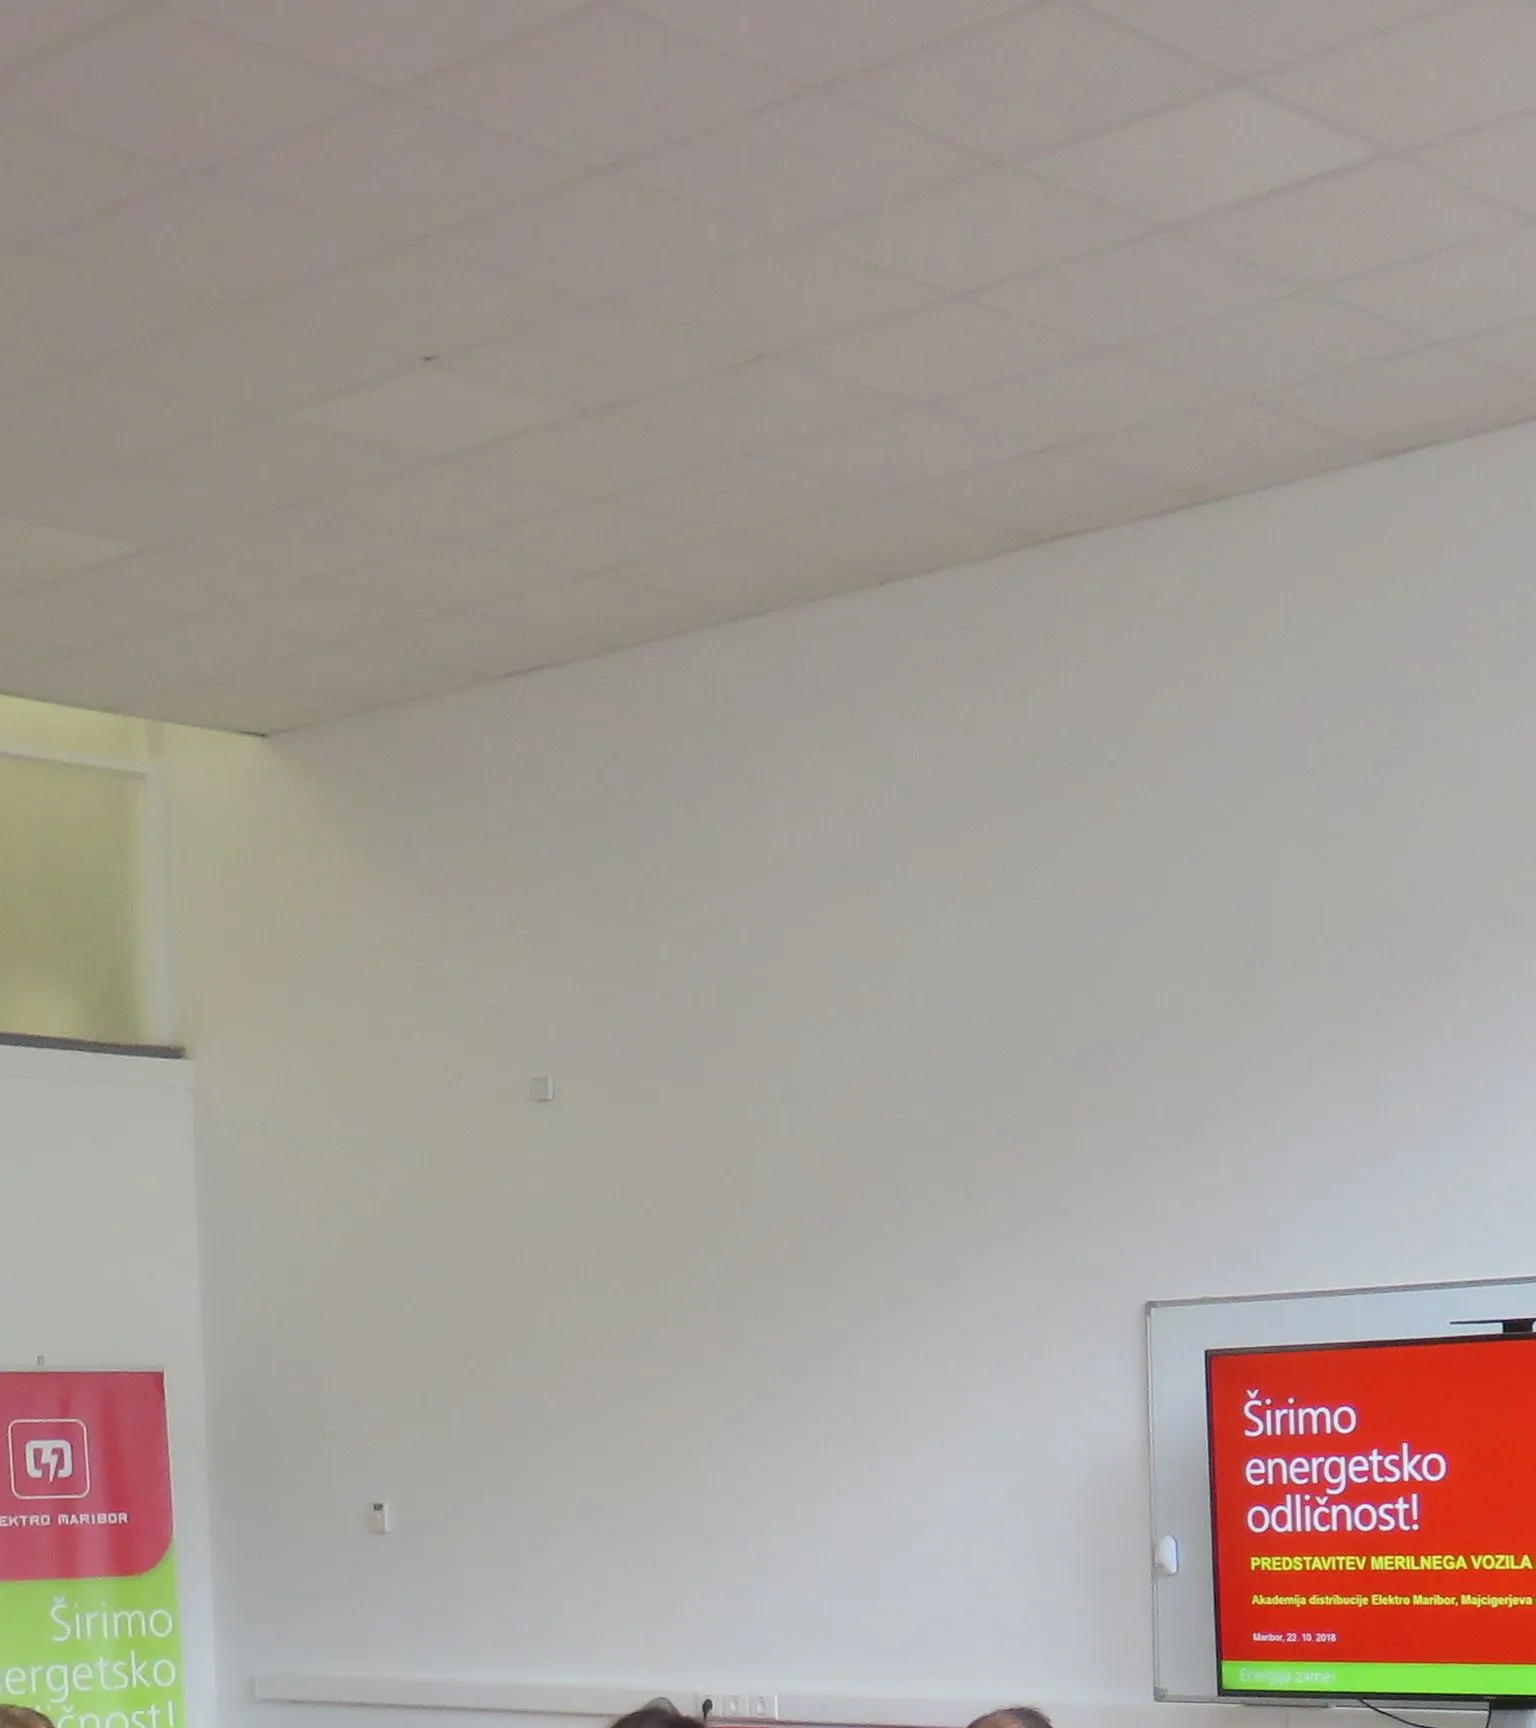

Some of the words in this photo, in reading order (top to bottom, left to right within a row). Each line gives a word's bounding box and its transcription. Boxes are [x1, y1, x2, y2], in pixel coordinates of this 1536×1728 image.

[1243, 1388, 1357, 1437] Širimo
[1245, 1442, 1447, 1495] energetsko
[57, 1512, 129, 1525] MARIBOR
[1247, 1493, 1419, 1533] odličnost!
[1250, 1555, 1367, 1571] PREDSTAVITEV
[1370, 1554, 1468, 1571] MERILNEGA
[1471, 1553, 1534, 1570] VOZILA
[1251, 1593, 1307, 1608] Akademija
[1309, 1593, 1369, 1608] distribucije
[1371, 1594, 1410, 1606] Elektro
[1413, 1593, 1459, 1608] Maribor,
[50, 1596, 173, 1643] Širimo
[1315, 1632, 1337, 1643] 2018
